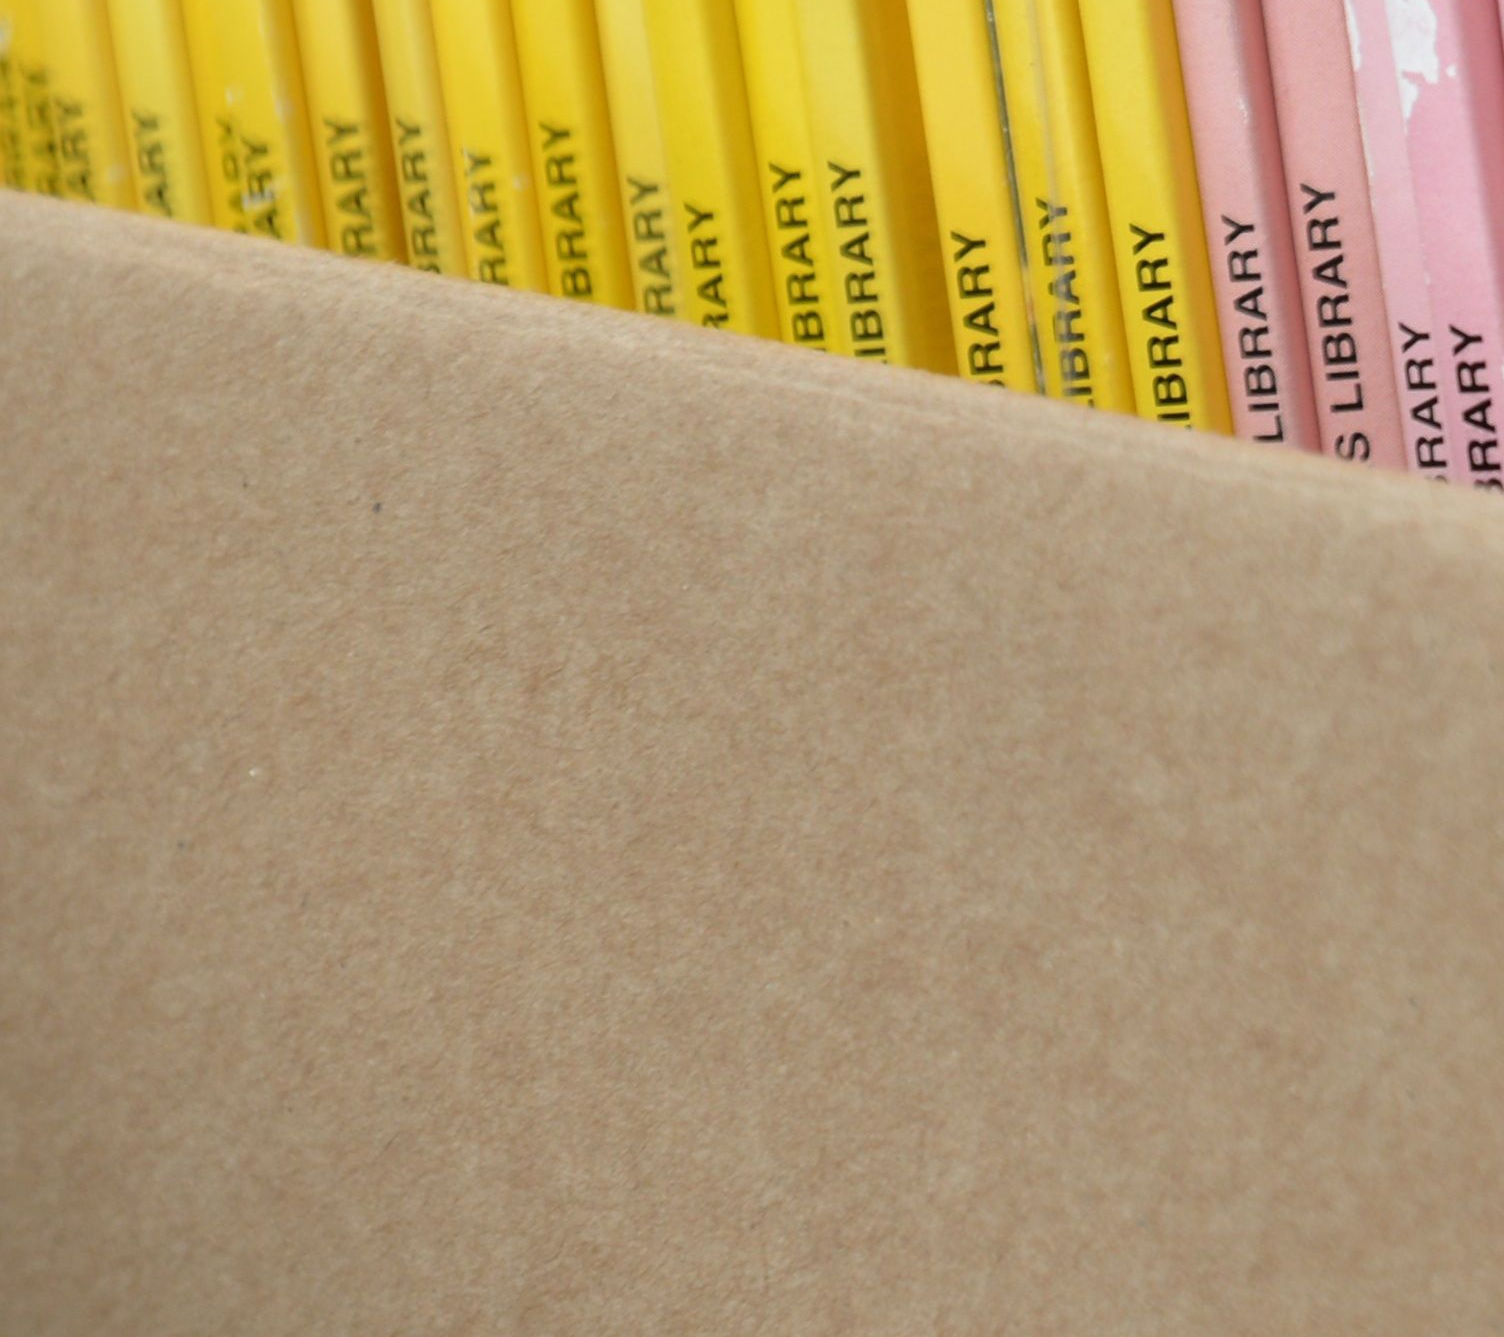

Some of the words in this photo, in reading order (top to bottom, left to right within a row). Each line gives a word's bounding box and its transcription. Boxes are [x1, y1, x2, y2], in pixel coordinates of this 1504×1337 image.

[826, 160, 888, 364] IBRARY
[1220, 213, 1285, 444] LIBRARY
[1299, 182, 1365, 413] LIBRARY
